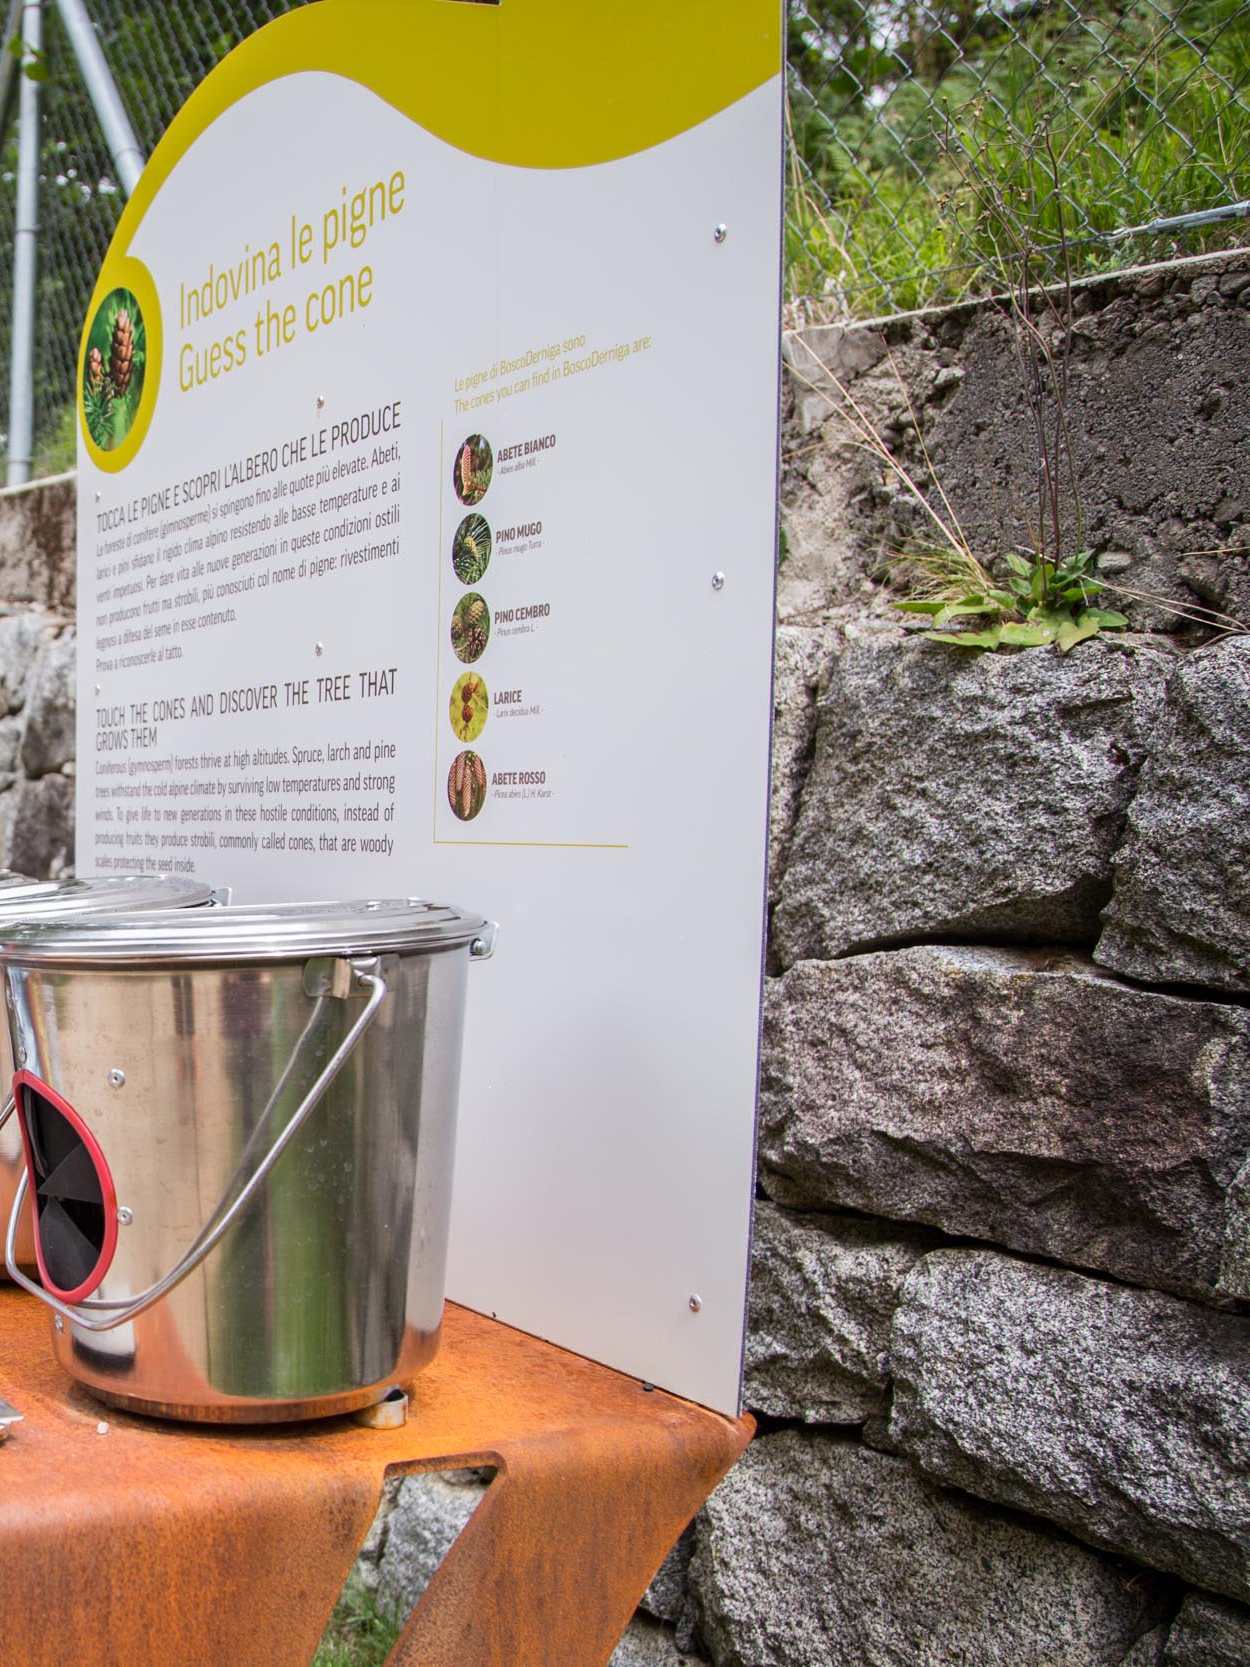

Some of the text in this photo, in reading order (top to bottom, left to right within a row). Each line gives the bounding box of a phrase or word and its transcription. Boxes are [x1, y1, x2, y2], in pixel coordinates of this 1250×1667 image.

[180, 170, 405, 330] Indovina le pigne
[179, 265, 373, 392] Guess the cone
[563, 335, 585, 353] sono
[496, 384, 512, 402] you
[514, 378, 530, 393] can
[497, 434, 556, 463] ABETE BIANCO
[97, 401, 401, 533] TOCCA LE PIGNE E SCOPRI L'ALBERO CHE LE PRODUCE
[219, 494, 254, 519] spingono
[255, 488, 271, 505] fino
[272, 481, 287, 499] alle
[289, 474, 314, 498] quote
[316, 464, 330, 489] più
[332, 456, 368, 480] elevate.
[371, 441, 400, 467] Abeti,
[184, 538, 202, 553] clima
[205, 529, 227, 549] alpino
[230, 515, 270, 540] resistendo
[274, 509, 288, 527] alle
[291, 503, 316, 521] basse
[319, 484, 377, 513] temperature
[191, 561, 203, 577] alle
[207, 556, 228, 573] nuove
[231, 539, 277, 570] generazioni
[291, 530, 319, 554] queste
[323, 512, 371, 541] condizioni
[375, 504, 399, 527] ostili
[495, 521, 542, 544] PINO MUGO
[202, 584, 213, 604] più
[216, 573, 254, 597] conosciuti
[257, 569, 269, 587] col
[272, 567, 295, 583] nome
[310, 556, 337, 579] pigne:
[340, 536, 398, 567] rivestimenti
[494, 603, 550, 624] PINO CEMBRO
[96, 668, 397, 728] TOUCH THE CONES AND DISCOVER THE TREE THAT
[494, 690, 522, 705] LARICE
[96, 726, 157, 751] GROWS THEM
[200, 752, 221, 769] thrive
[223, 752, 232, 767] at
[234, 749, 250, 771] high
[252, 747, 289, 765] altitudes.
[292, 746, 324, 768] Spruce,
[327, 742, 350, 761] larch
[353, 740, 371, 760] and
[374, 739, 395, 763] pine
[190, 780, 215, 795] climate
[217, 779, 226, 798] by
[228, 777, 263, 797] surviving
[266, 776, 280, 792] low
[282, 776, 341, 796] temperatures
[343, 772, 360, 790] and
[363, 773, 395, 794] strong
[492, 771, 546, 785] ABETE ROSSO
[180, 805, 221, 824] generations
[235, 805, 256, 820] these
[260, 804, 287, 820] hostile
[291, 803, 339, 823] conditions,
[344, 802, 379, 820] instead
[384, 802, 394, 820] of
[219, 833, 258, 852] commonly
[261, 833, 285, 849] called
[289, 837, 315, 852] cones,
[319, 833, 338, 850] that
[341, 838, 356, 851] are
[360, 834, 393, 856] woody
